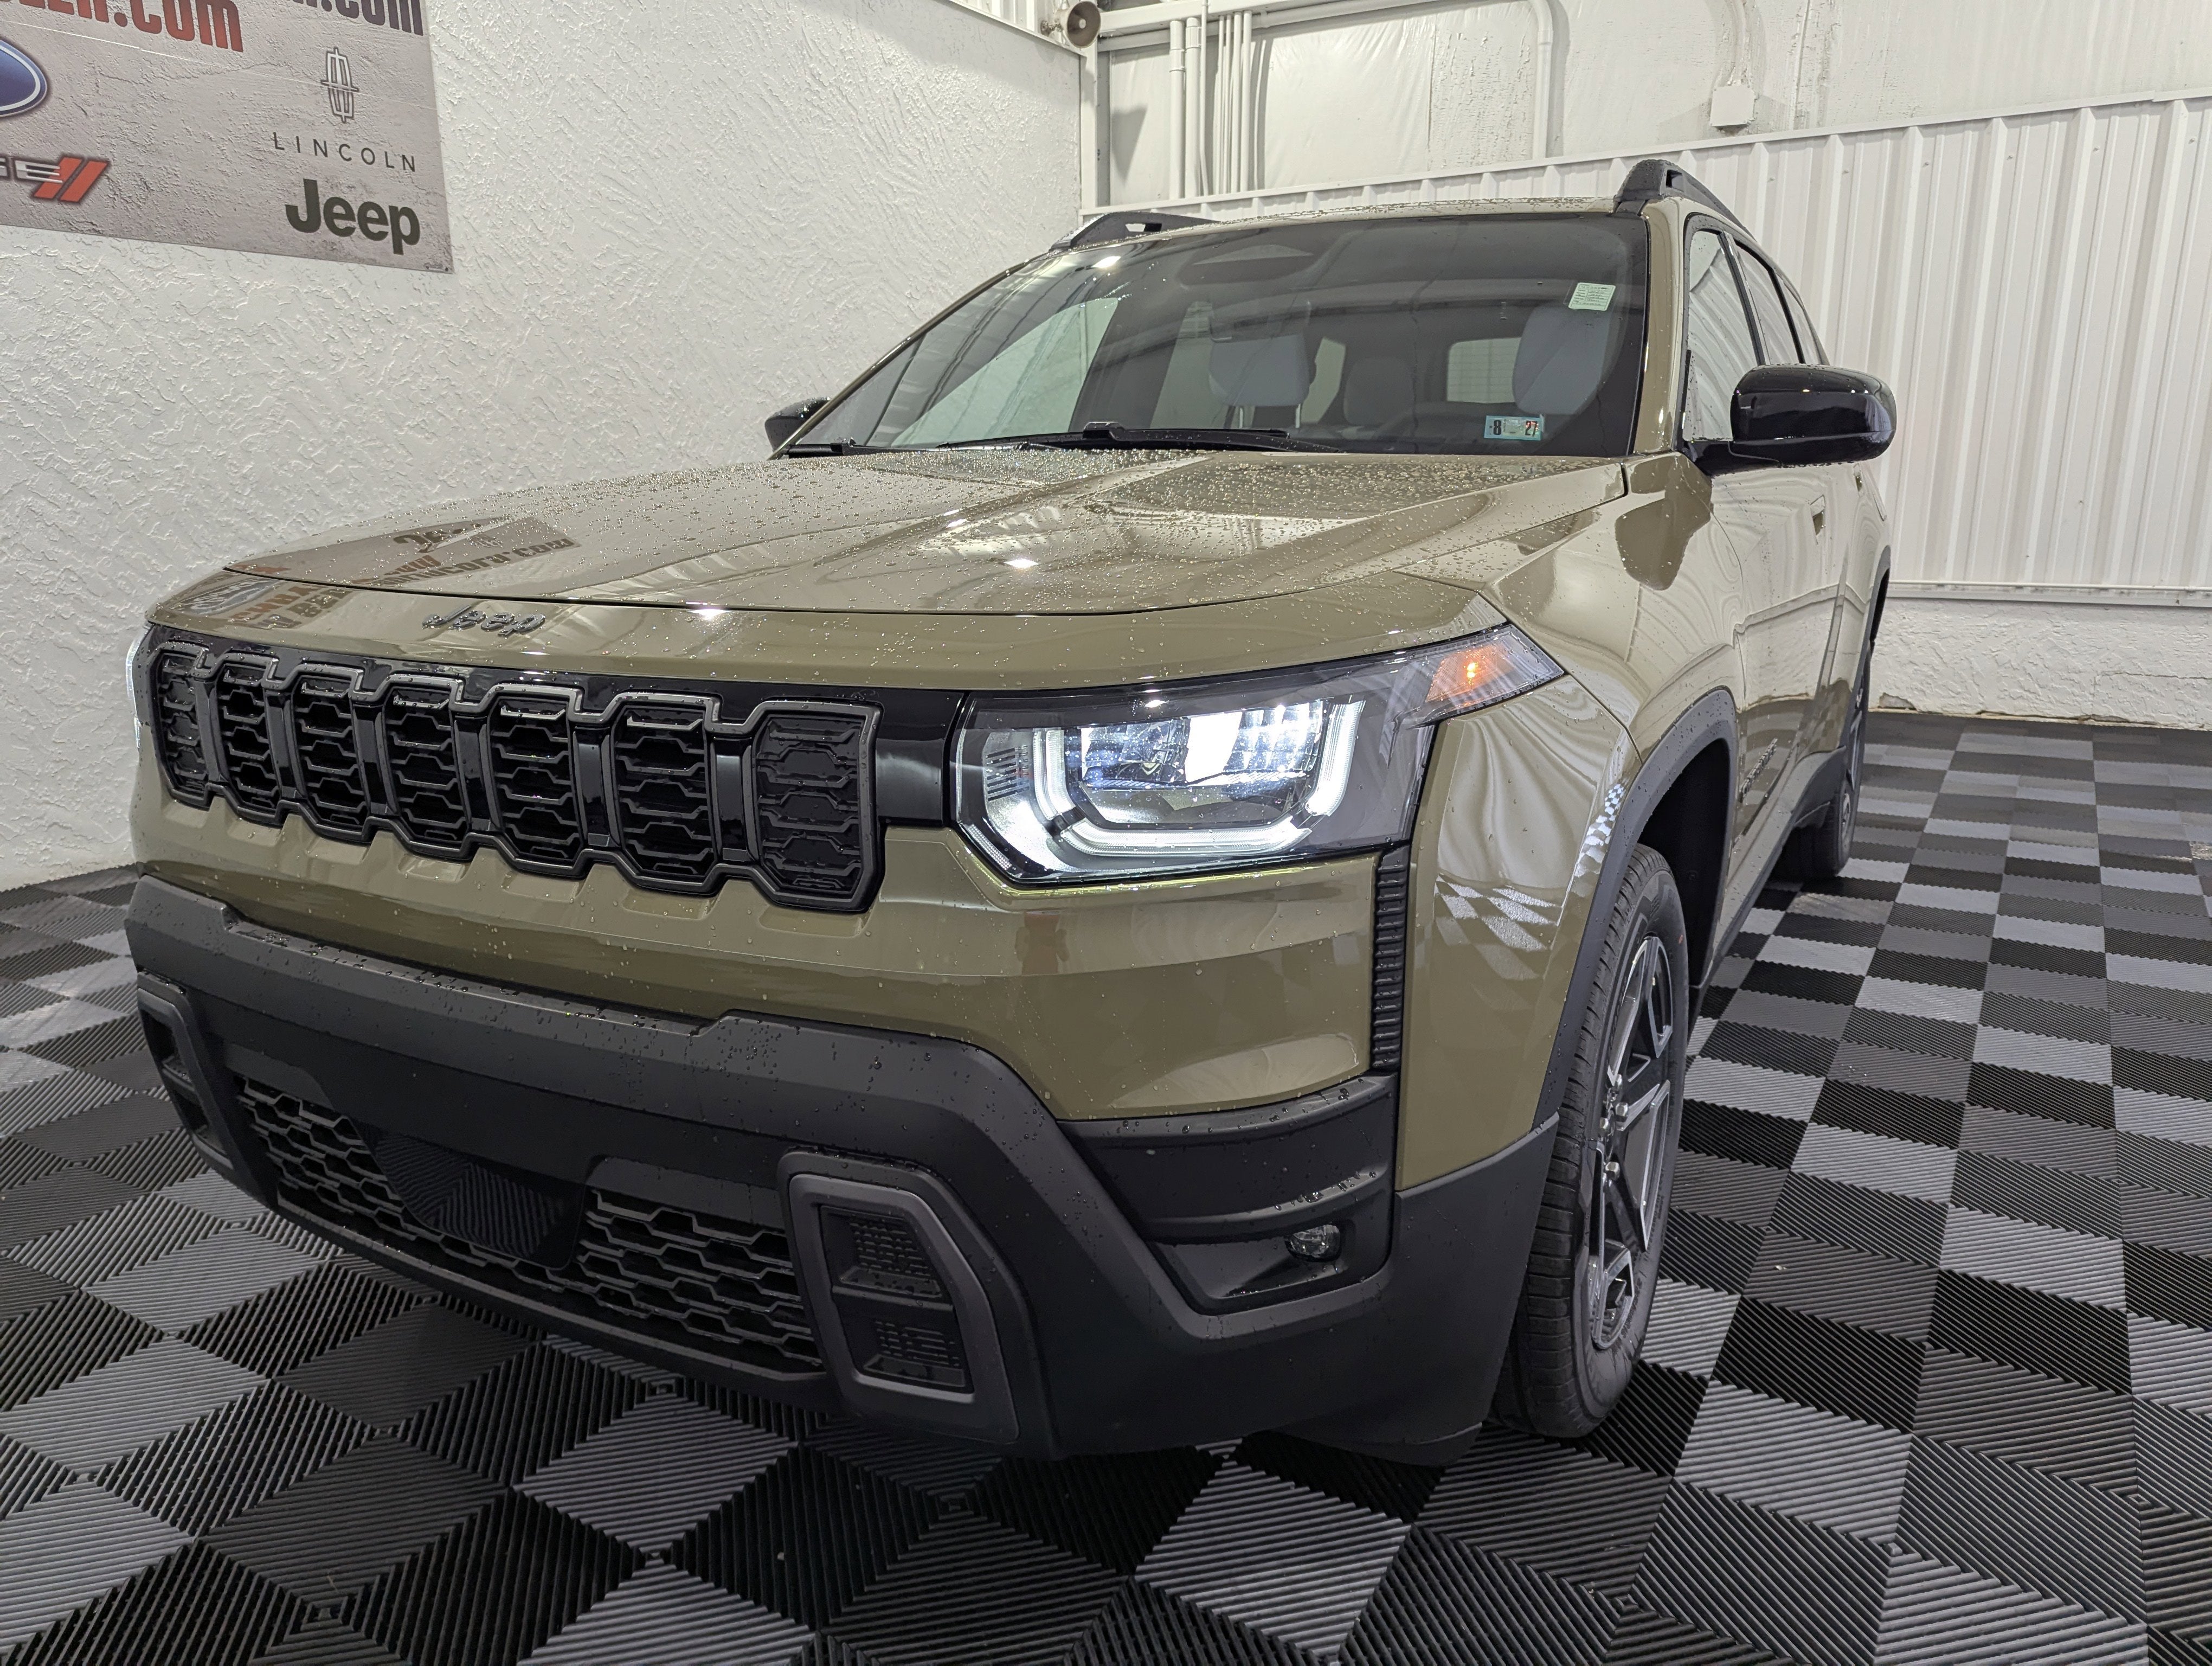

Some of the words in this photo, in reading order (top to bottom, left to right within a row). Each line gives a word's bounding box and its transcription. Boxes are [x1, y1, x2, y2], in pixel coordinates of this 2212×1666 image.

[273, 132, 415, 172] LINCOLN
[285, 178, 421, 255] Jeep
[1493, 419, 1502, 435] 8
[1525, 420, 1539, 437] 27
[422, 605, 546, 637] Jeep
